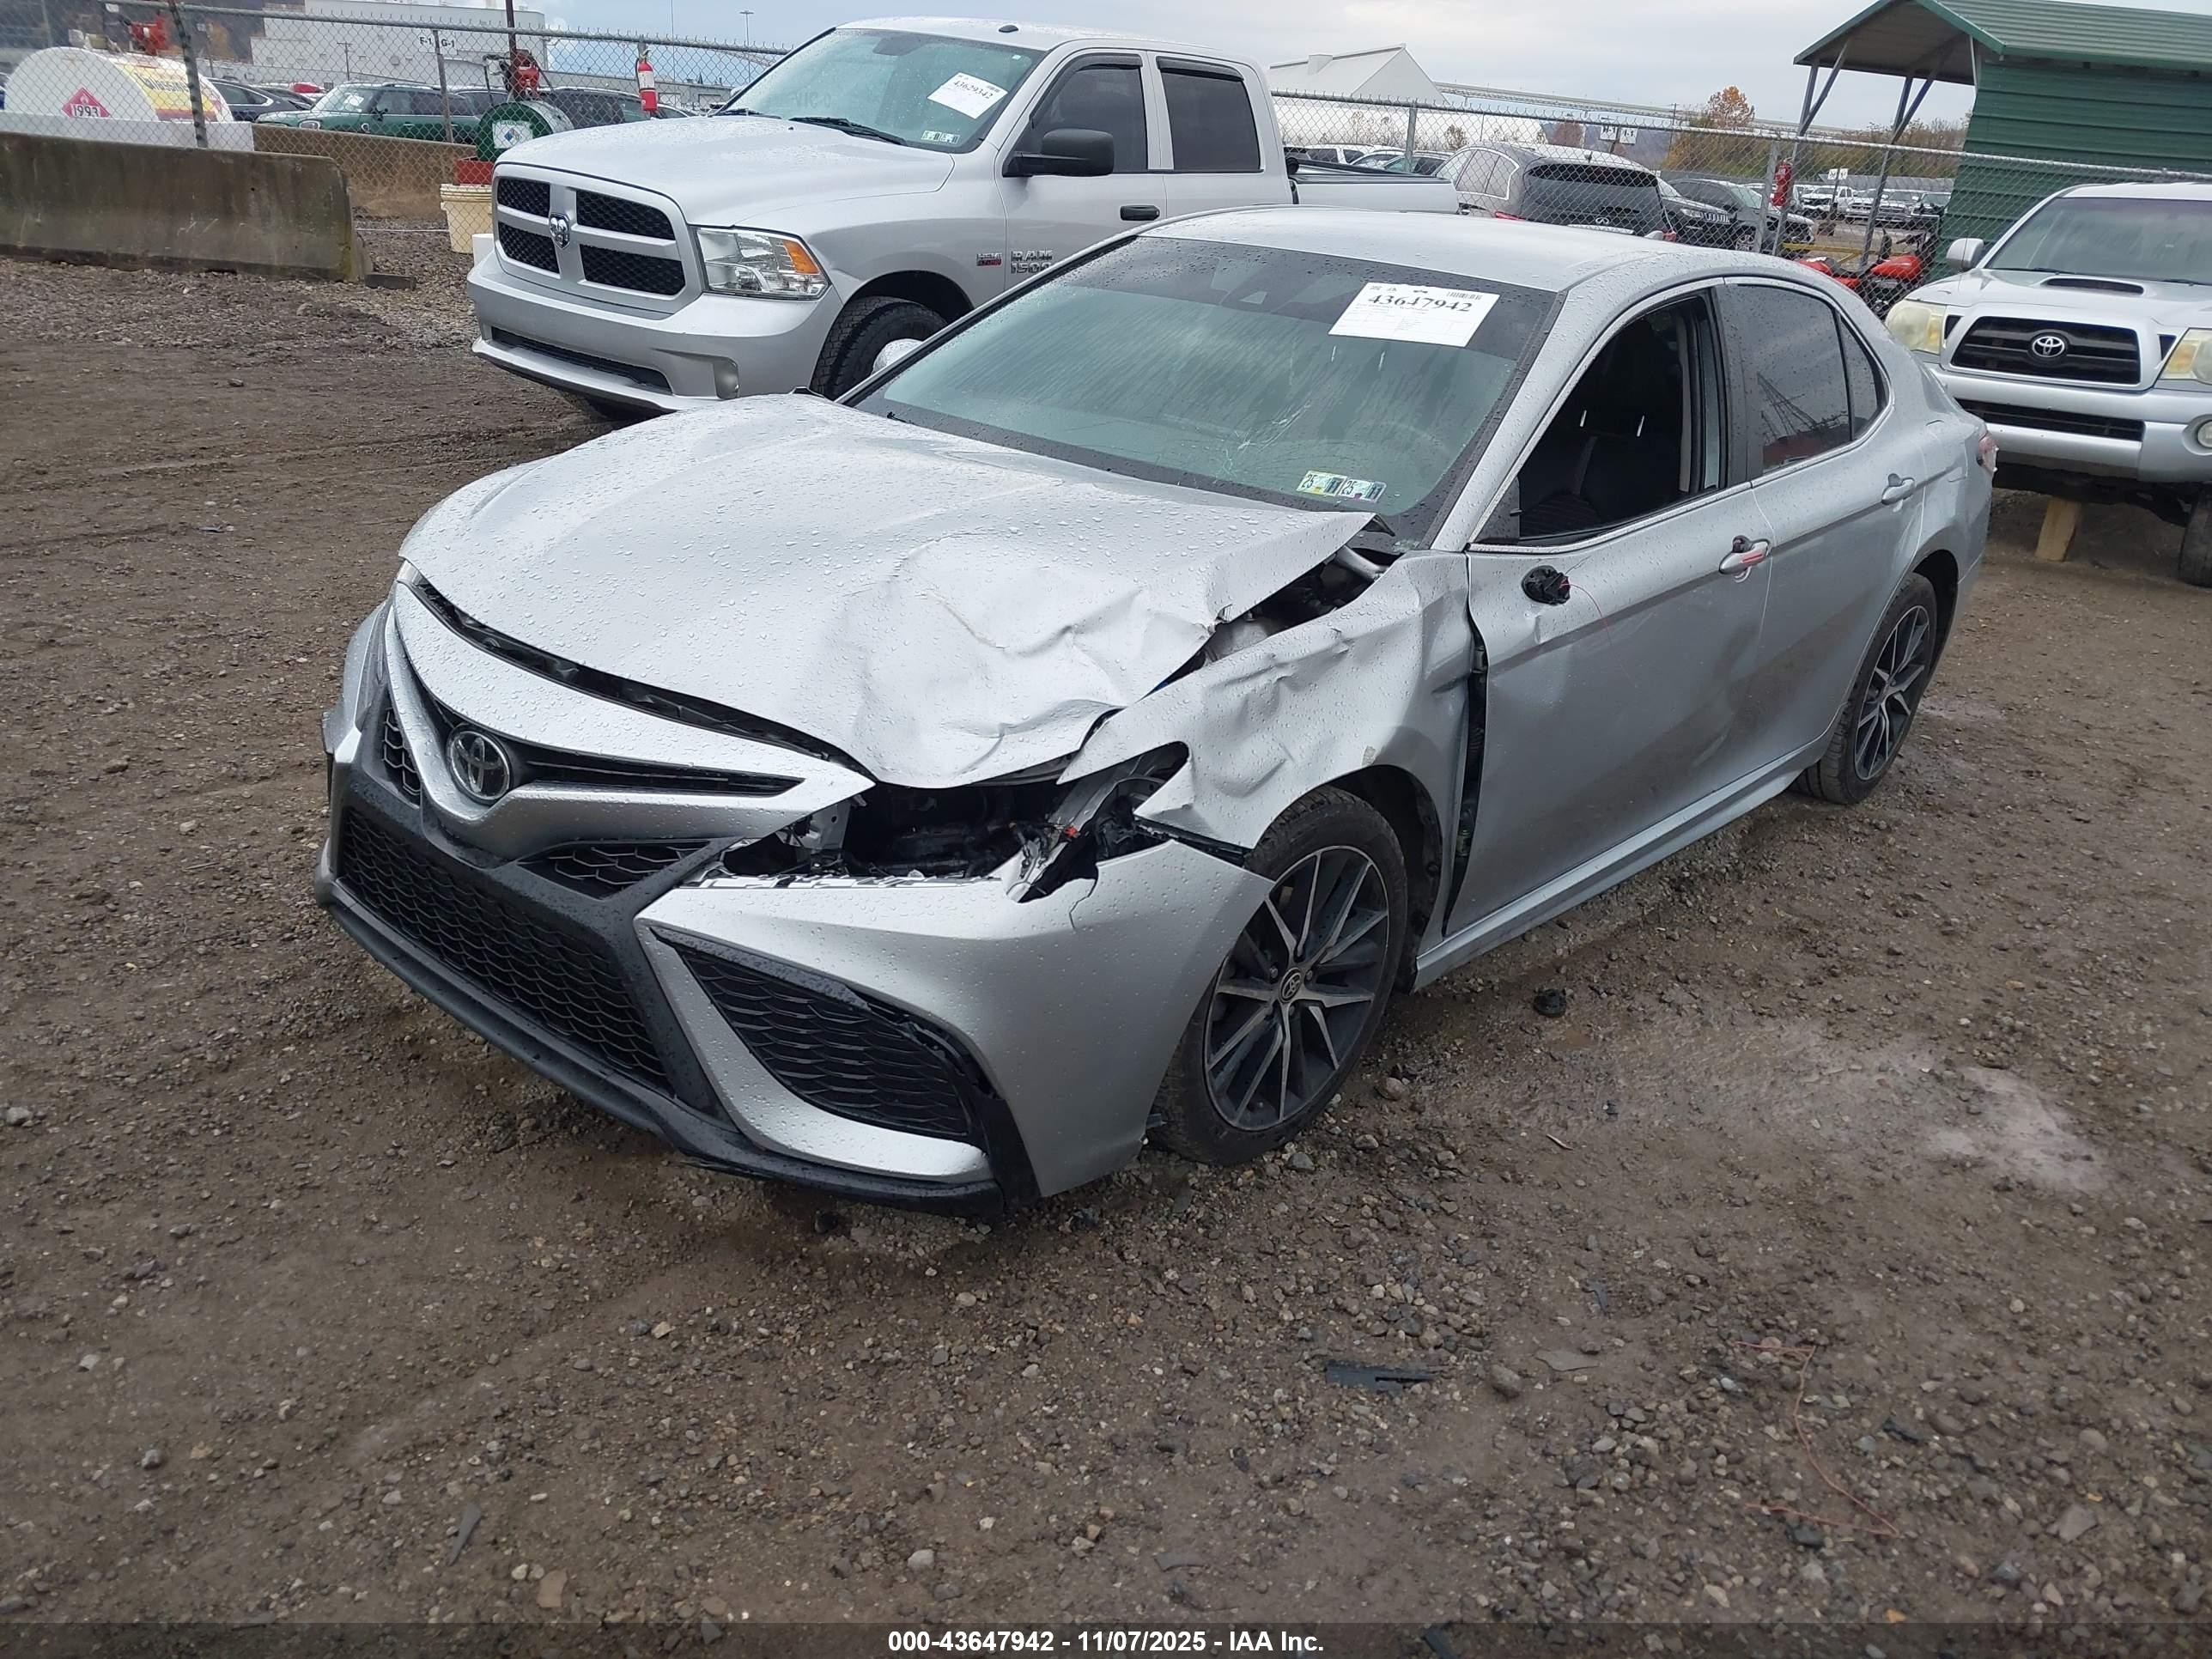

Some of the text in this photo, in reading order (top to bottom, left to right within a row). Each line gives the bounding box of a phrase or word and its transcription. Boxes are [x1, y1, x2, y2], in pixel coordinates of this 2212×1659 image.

[441, 39, 455, 48] G-1
[73, 105, 100, 117] 1993
[1011, 250, 1053, 261] RAM
[1368, 294, 1474, 312] 43647942
[1302, 474, 1317, 489] 25
[1342, 480, 1357, 495] 25
